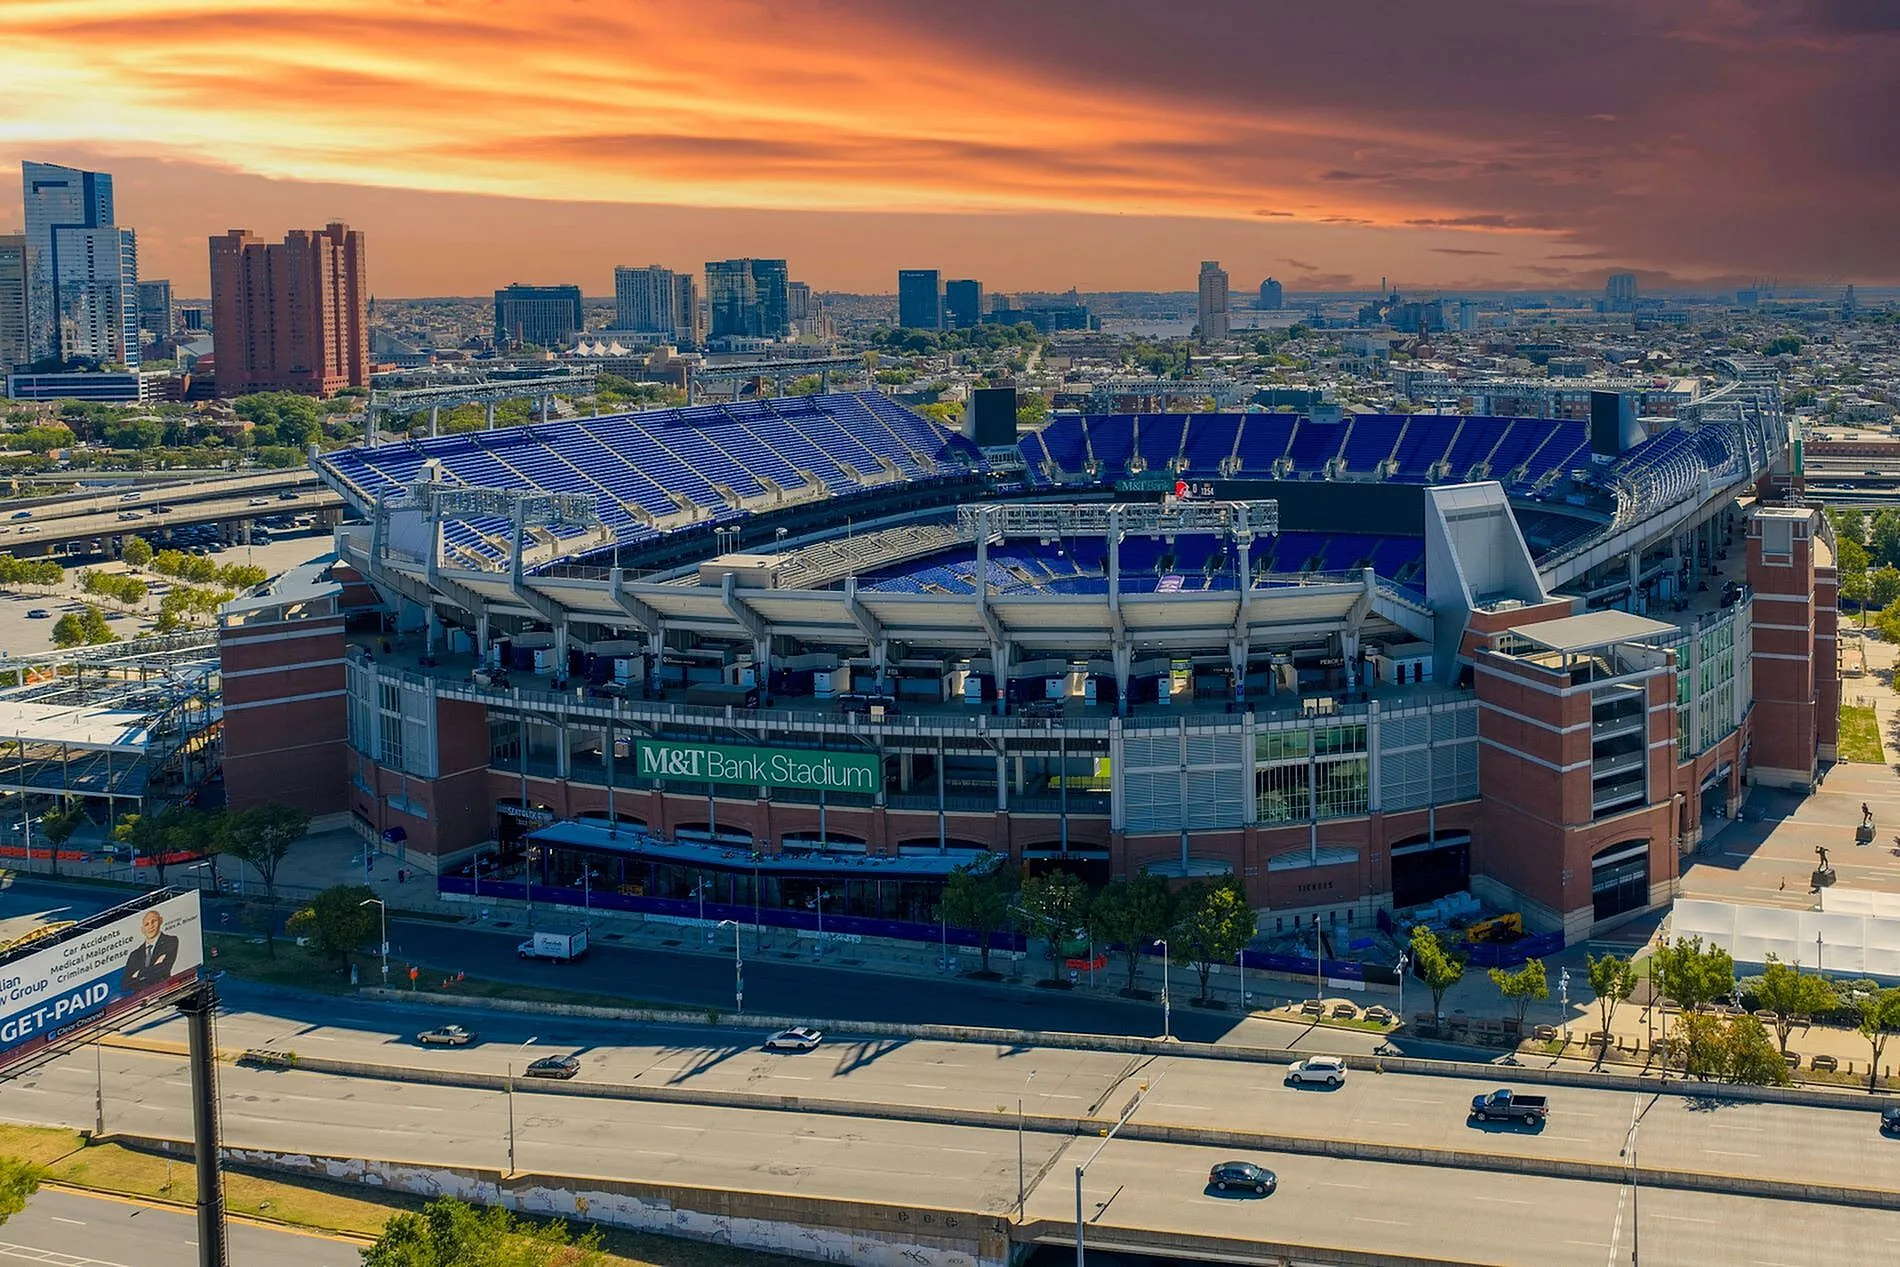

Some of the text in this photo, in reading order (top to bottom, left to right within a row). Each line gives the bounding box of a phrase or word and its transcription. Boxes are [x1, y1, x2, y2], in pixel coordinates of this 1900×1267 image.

[642, 746, 873, 788] M&T Bank Stadium
[50, 936, 134, 975] Medical Malpractice
[63, 930, 120, 957] Car Accidents
[56, 950, 129, 984] Criminal Defense
[11, 979, 48, 1000] Group
[1, 982, 109, 1042] GET-PAID
[57, 1010, 106, 1036] Clear Channel
